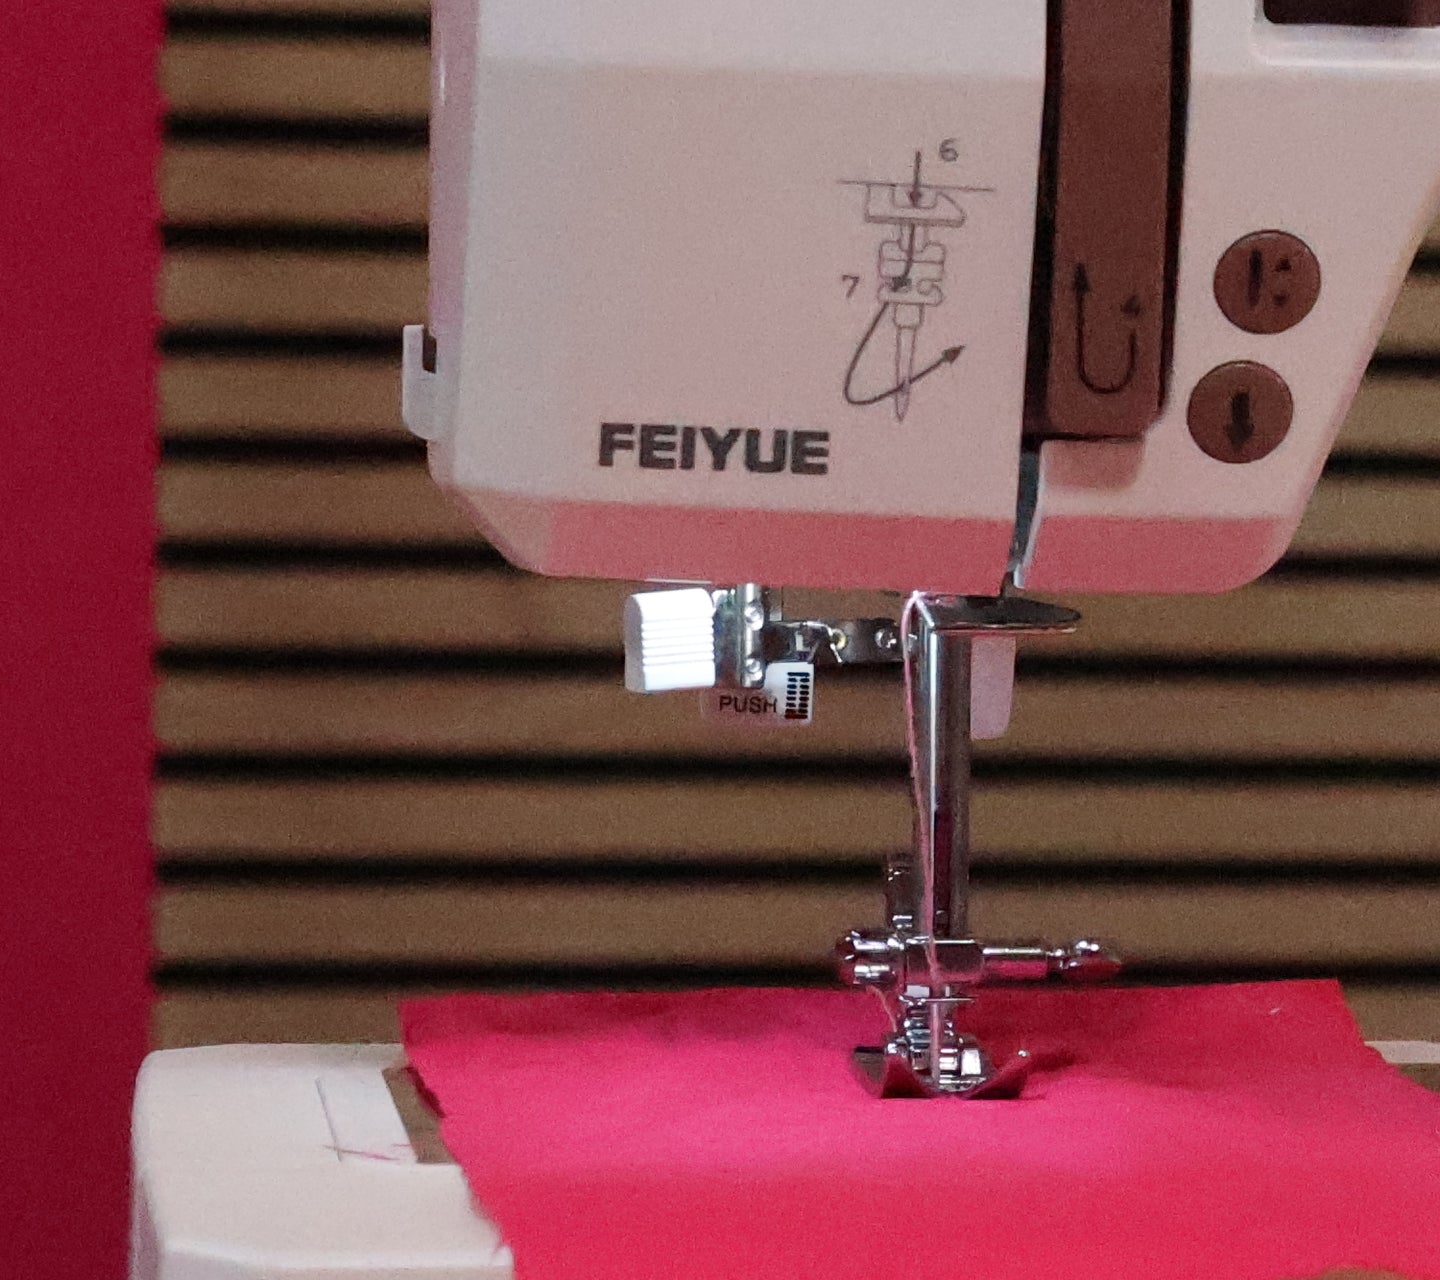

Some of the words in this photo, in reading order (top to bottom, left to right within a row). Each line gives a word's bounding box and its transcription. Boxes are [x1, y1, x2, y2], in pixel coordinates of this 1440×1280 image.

[938, 138, 960, 163] 6
[841, 274, 861, 299] 7
[597, 422, 830, 476] FEIYUE
[719, 695, 776, 715] PUSH
